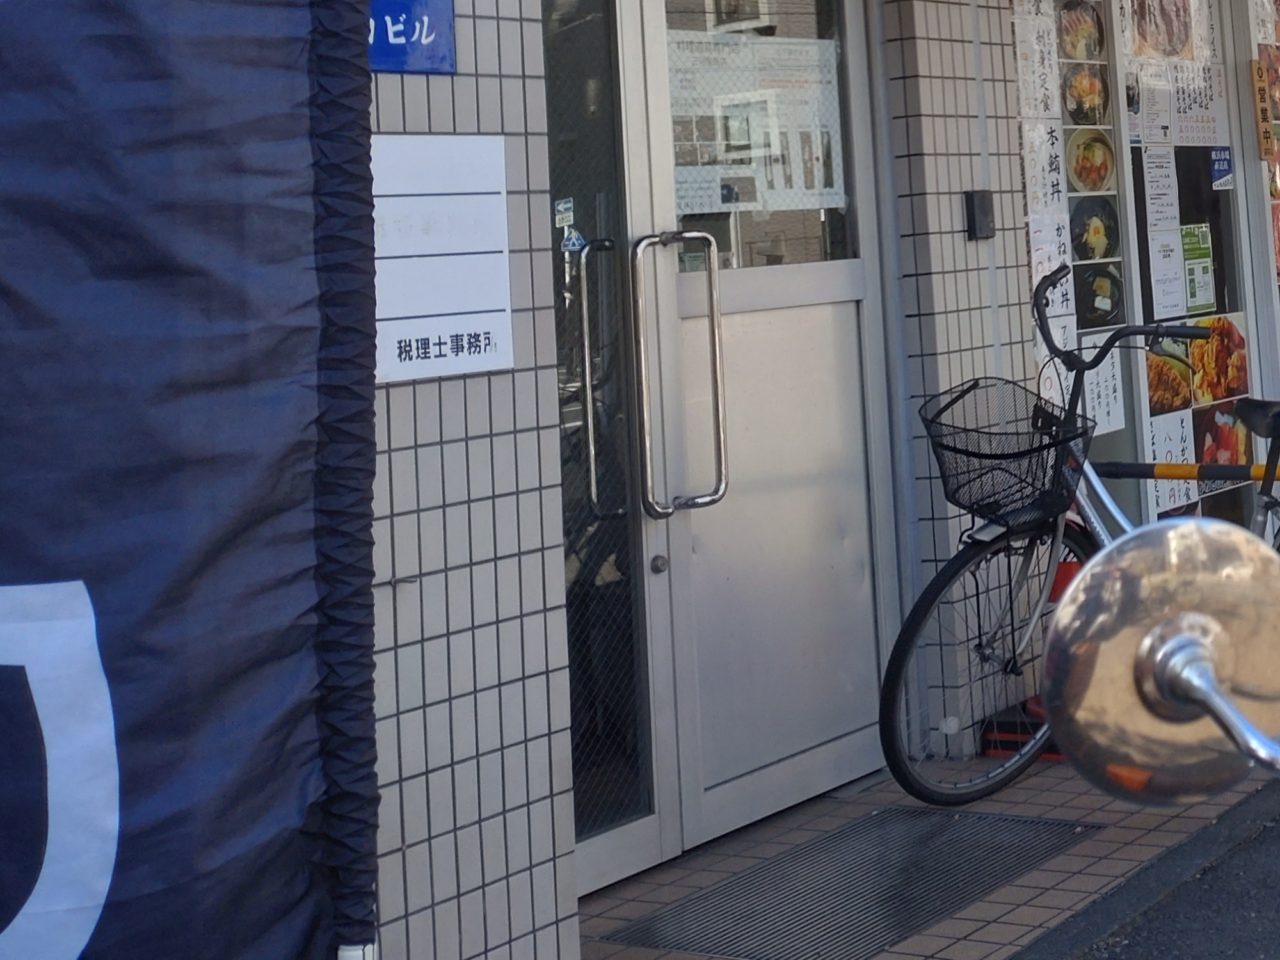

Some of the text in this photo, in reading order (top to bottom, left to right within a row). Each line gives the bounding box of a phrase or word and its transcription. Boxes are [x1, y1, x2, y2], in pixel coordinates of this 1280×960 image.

[1055, 223, 1071, 309] かねい丼
[397, 331, 498, 363] 税理士事務所
